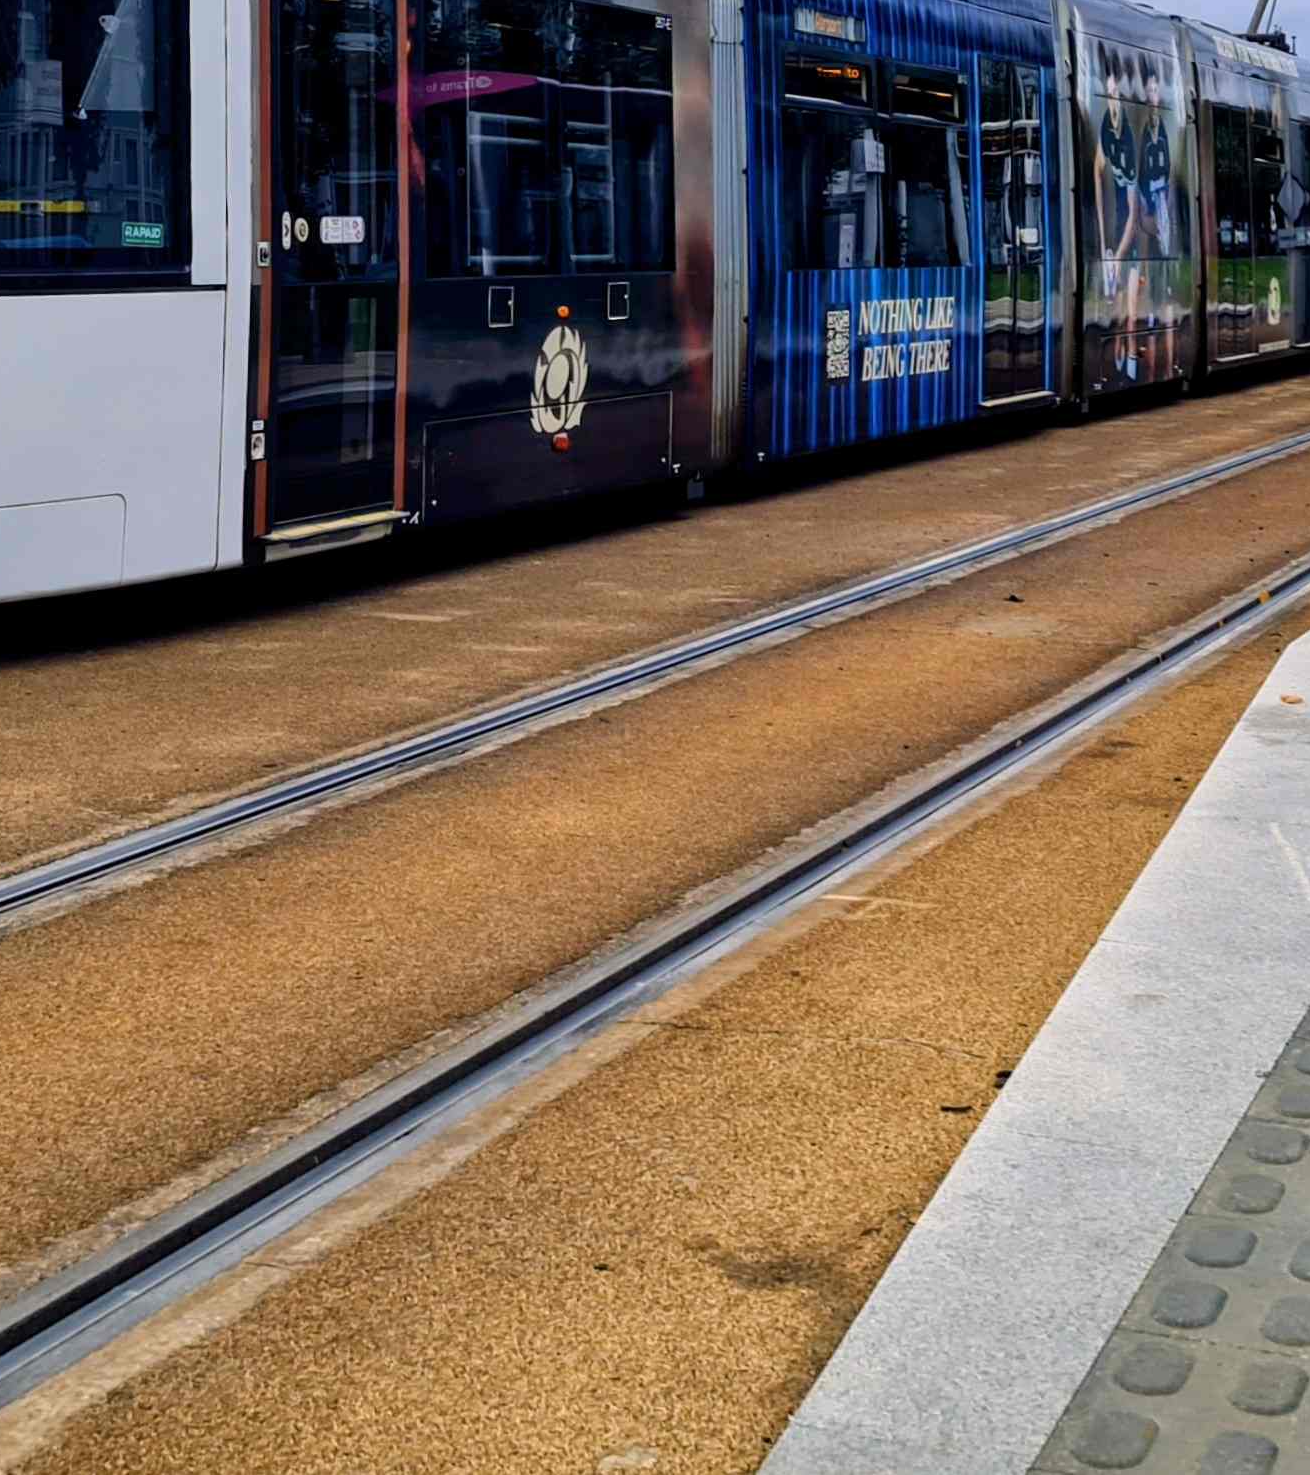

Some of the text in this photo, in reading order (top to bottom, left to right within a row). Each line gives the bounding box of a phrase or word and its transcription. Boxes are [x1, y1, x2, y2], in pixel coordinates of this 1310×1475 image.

[858, 296, 954, 335] NOTHING LIKE
[862, 339, 951, 382] BEING THERE
